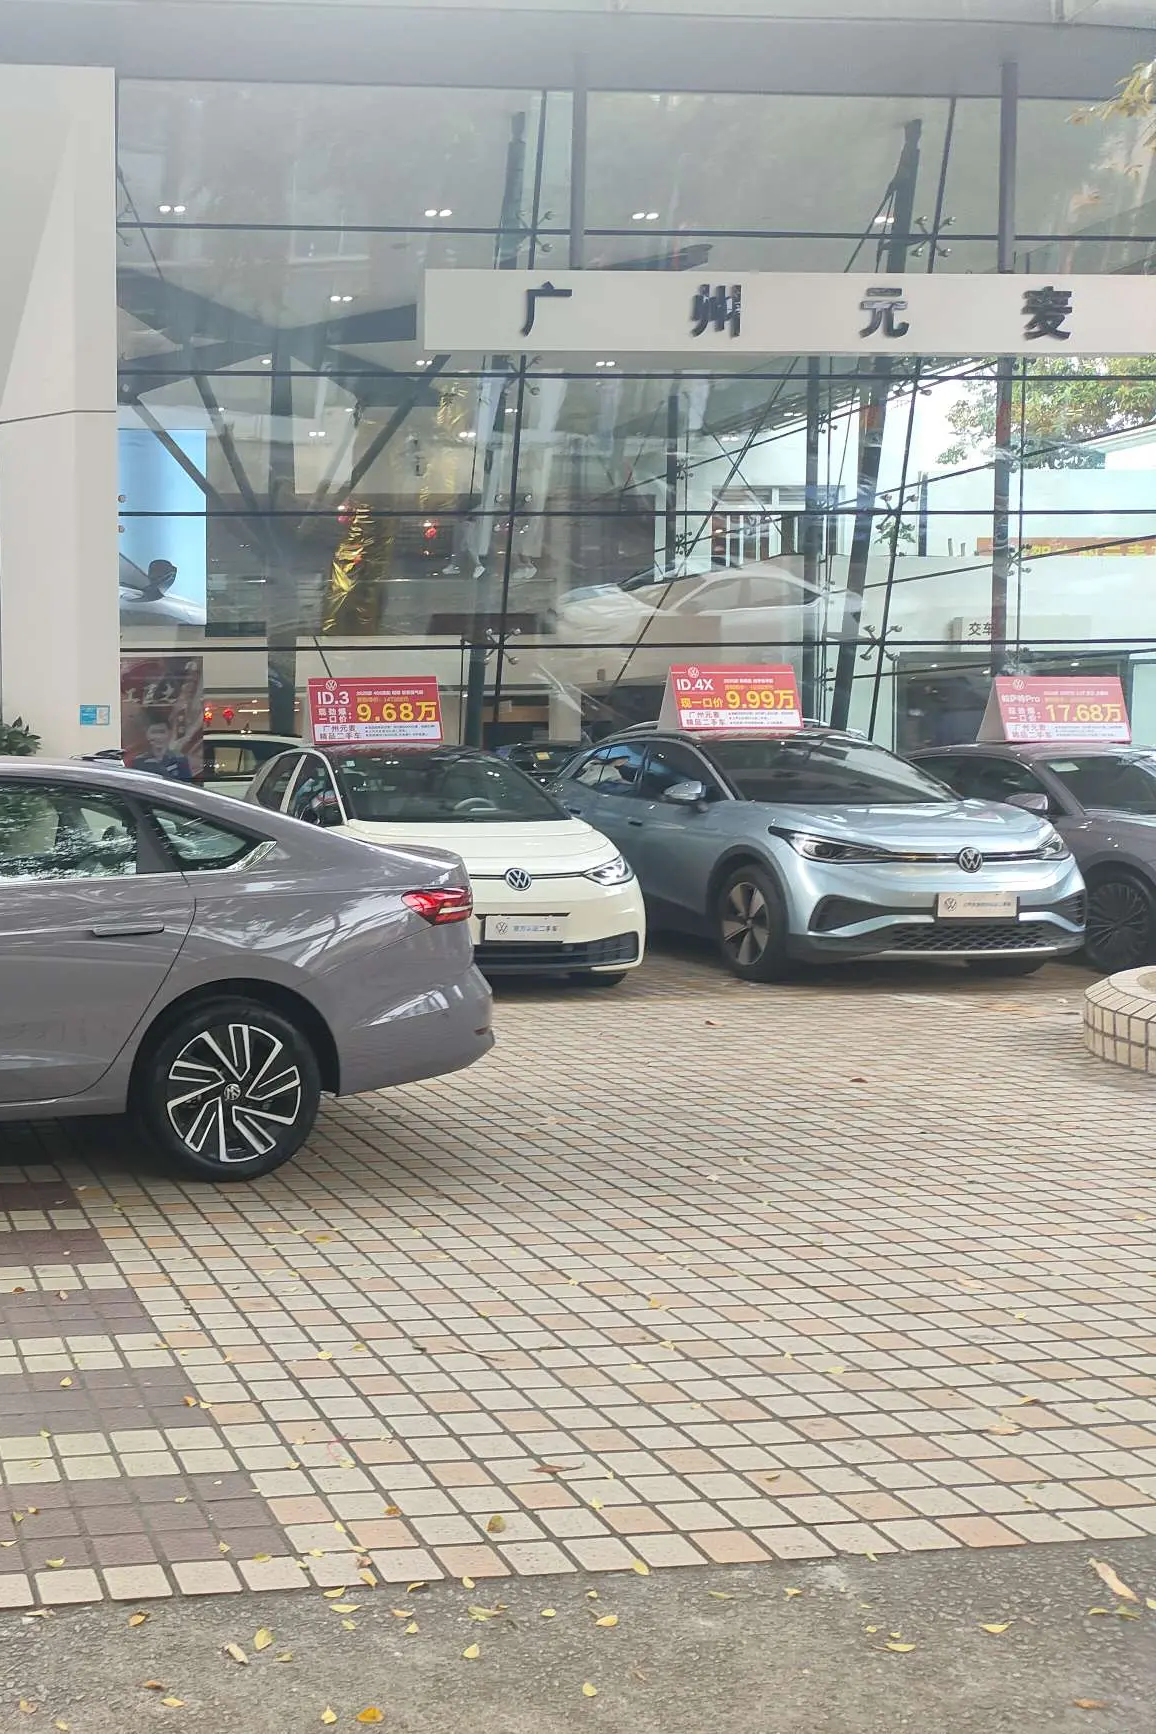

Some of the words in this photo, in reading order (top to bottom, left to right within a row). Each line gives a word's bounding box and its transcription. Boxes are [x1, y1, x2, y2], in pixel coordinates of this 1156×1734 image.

[521, 281, 1073, 341] 广州元麦
[676, 678, 714, 691] ID.4X
[317, 691, 350, 705] ID.3
[725, 689, 795, 709] 9.99万
[356, 701, 438, 722] 9.68万
[1045, 703, 1122, 722] 17.68万
